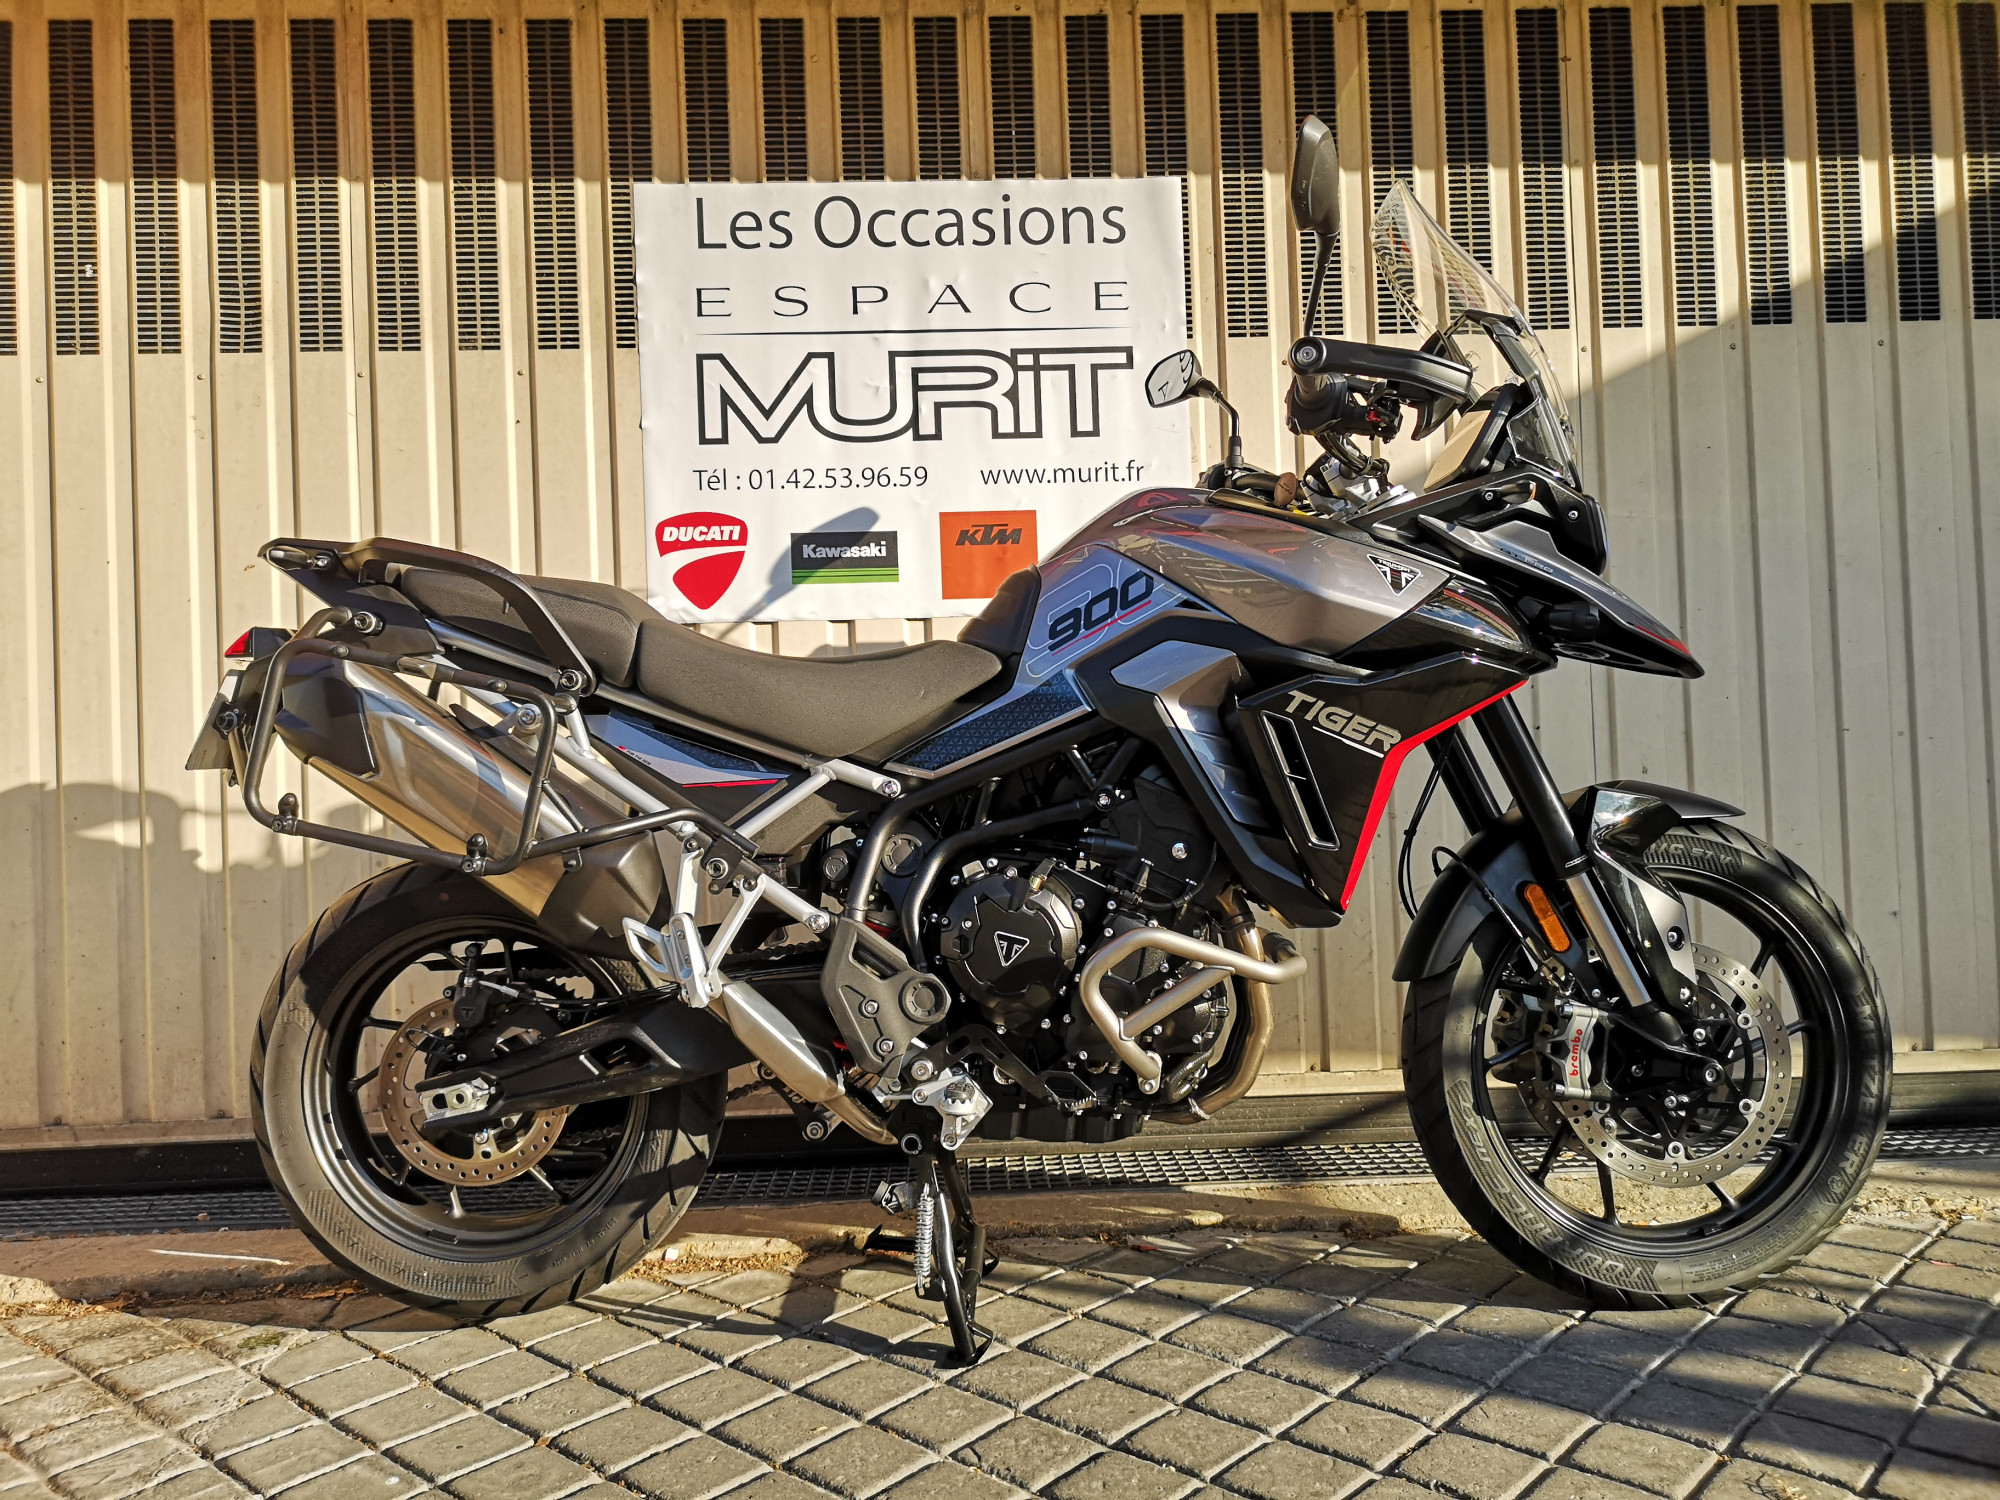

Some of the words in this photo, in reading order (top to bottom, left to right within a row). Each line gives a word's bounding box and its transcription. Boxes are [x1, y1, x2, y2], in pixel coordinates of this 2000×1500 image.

[695, 197, 793, 250] Les
[814, 193, 1127, 249] Occasions
[695, 281, 1130, 318] ESPACE
[748, 466, 928, 490] 01.42.53.96.59
[980, 459, 1144, 486] www.murit.fr
[662, 525, 741, 542] DUCATI
[955, 523, 1023, 547] KTM
[802, 541, 887, 559] Kawasaki
[1048, 570, 1154, 652] 900
[1285, 689, 1402, 752] TIGER
[1568, 1028, 1583, 1077] brembo
